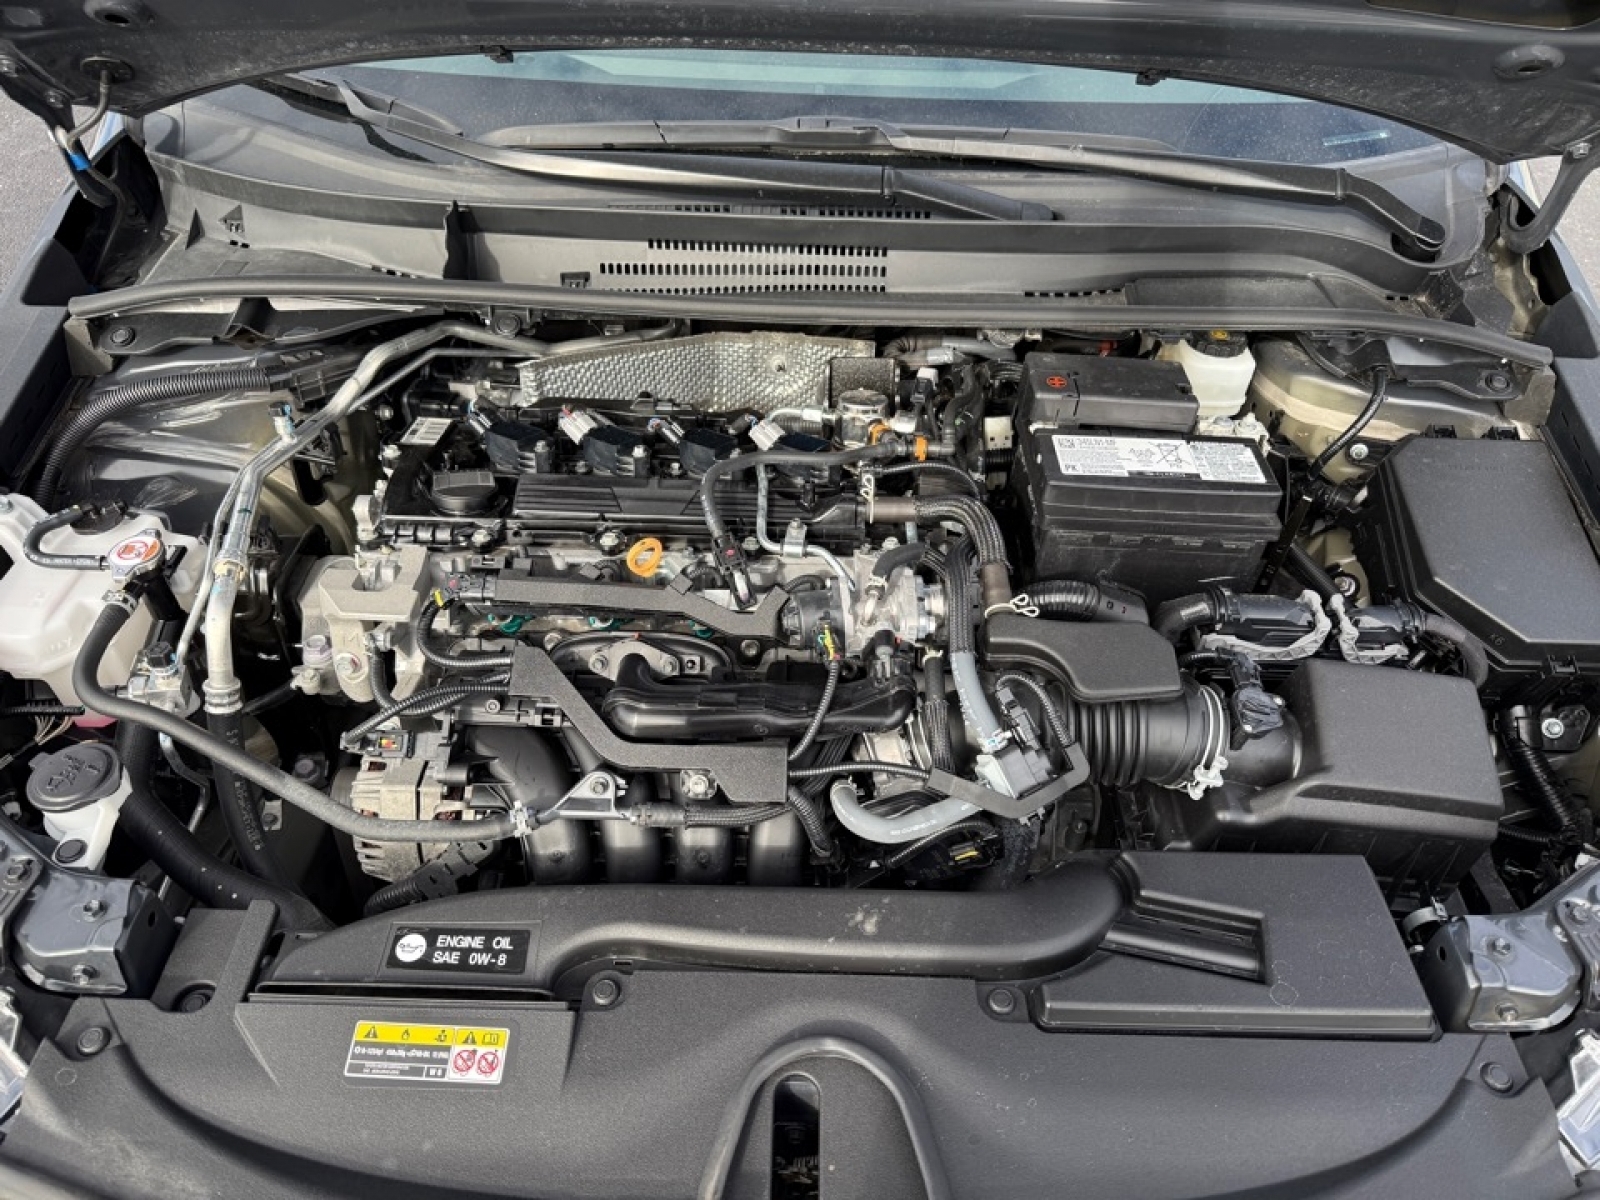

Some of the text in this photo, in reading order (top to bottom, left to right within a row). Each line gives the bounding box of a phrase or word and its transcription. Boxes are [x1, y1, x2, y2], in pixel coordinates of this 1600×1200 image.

[436, 934, 514, 950] ENGINE OIL
[432, 951, 507, 966] SAE 0W-8
